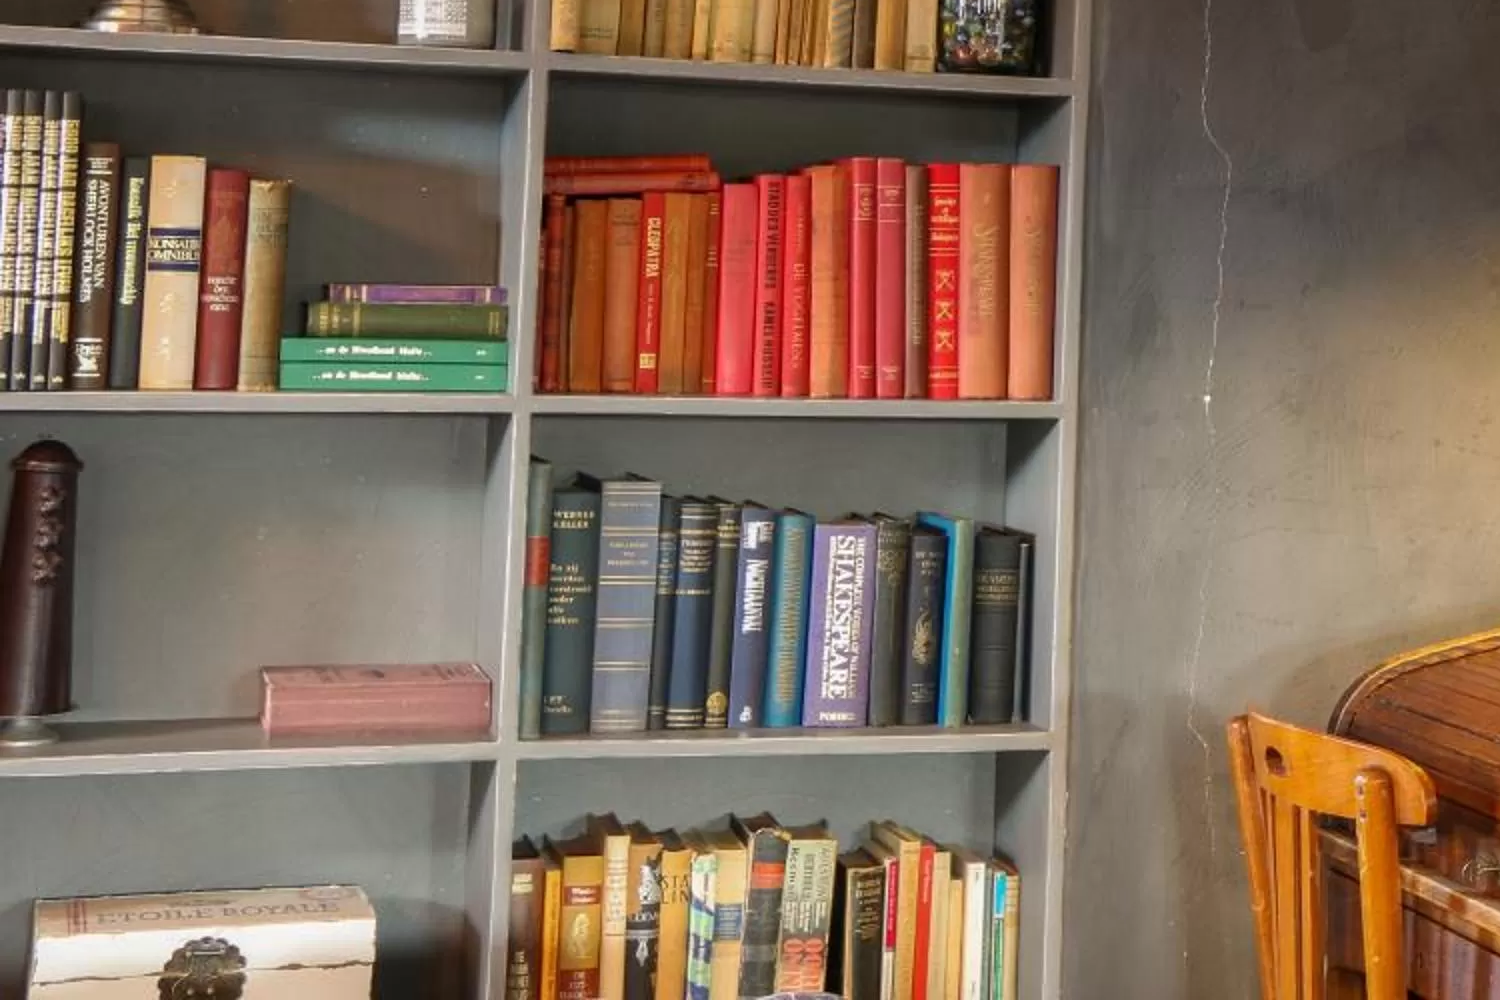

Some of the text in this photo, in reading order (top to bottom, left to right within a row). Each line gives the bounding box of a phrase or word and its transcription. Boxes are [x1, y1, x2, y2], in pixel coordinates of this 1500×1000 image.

[78, 178, 100, 303] SHERLOCK HOLMES
[93, 179, 112, 288] AVONTUREN VAN
[645, 217, 662, 277] CLEOPATRA
[827, 535, 857, 700] SHAKESPEARE
[96, 901, 341, 925] ETOILE ROYALE
